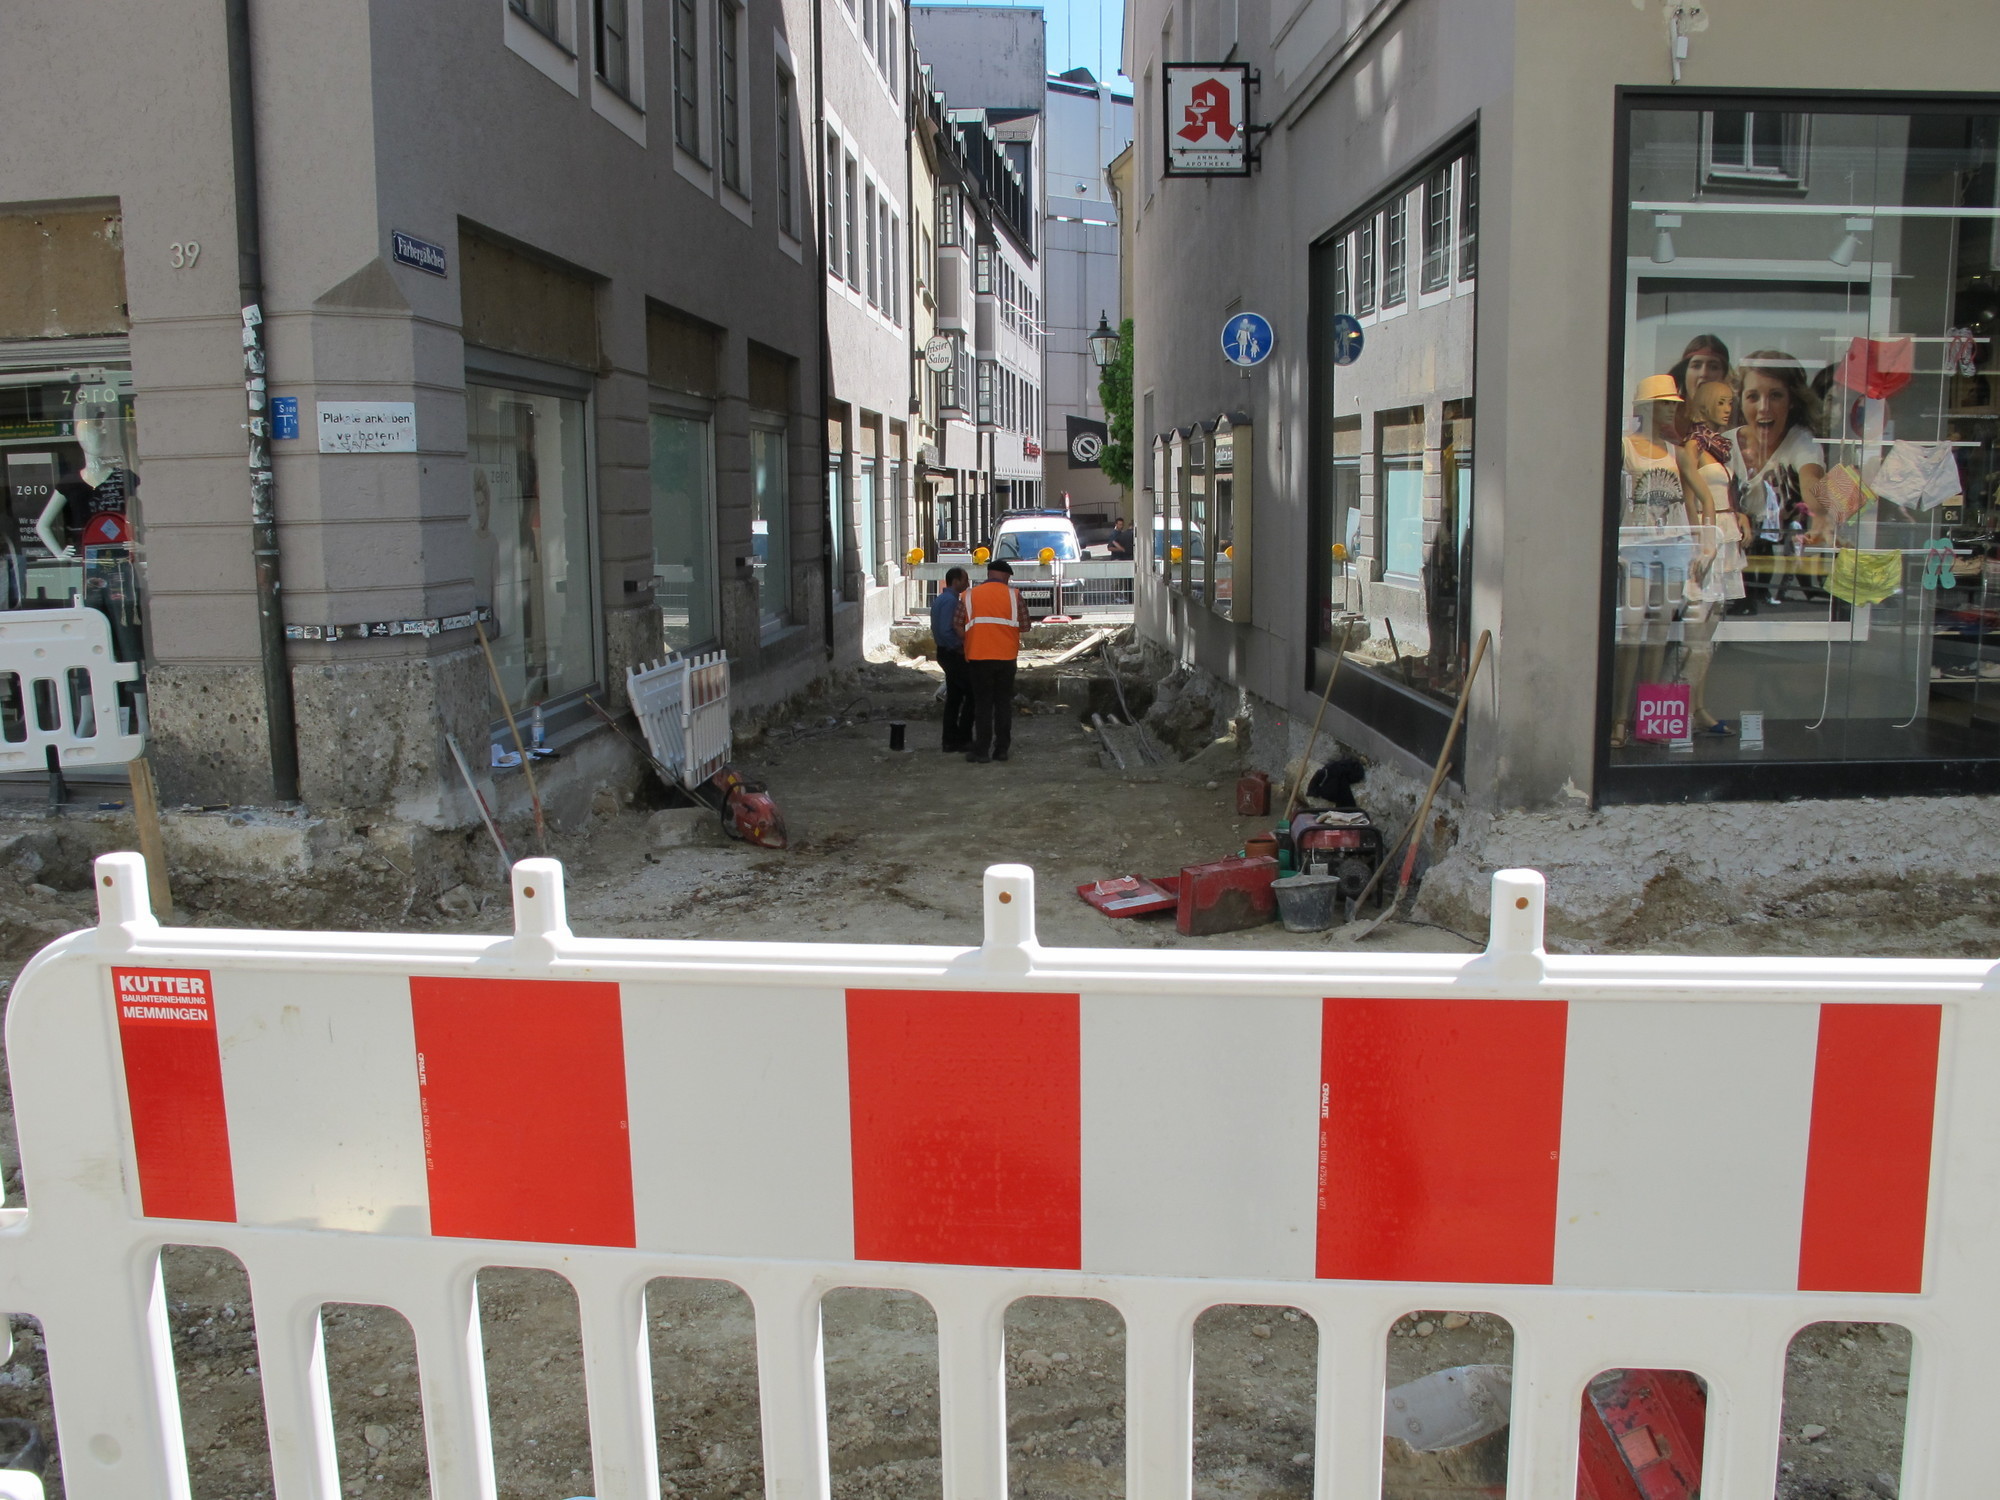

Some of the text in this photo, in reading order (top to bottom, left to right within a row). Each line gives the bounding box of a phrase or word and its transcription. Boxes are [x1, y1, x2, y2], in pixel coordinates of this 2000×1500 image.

[170, 241, 200, 269] 39
[928, 354, 950, 364] Salon
[62, 388, 117, 405] zero
[365, 413, 410, 423] ankben
[337, 431, 400, 441] veboten!
[17, 485, 48, 496] zero
[120, 976, 205, 994] KUTTER
[122, 994, 206, 1005] BAUUNTERNEHMUNG
[123, 1006, 208, 1021] MEMMINGEN
[418, 1052, 426, 1086] ORALITE
[1321, 1083, 1329, 1119] ORALITE
